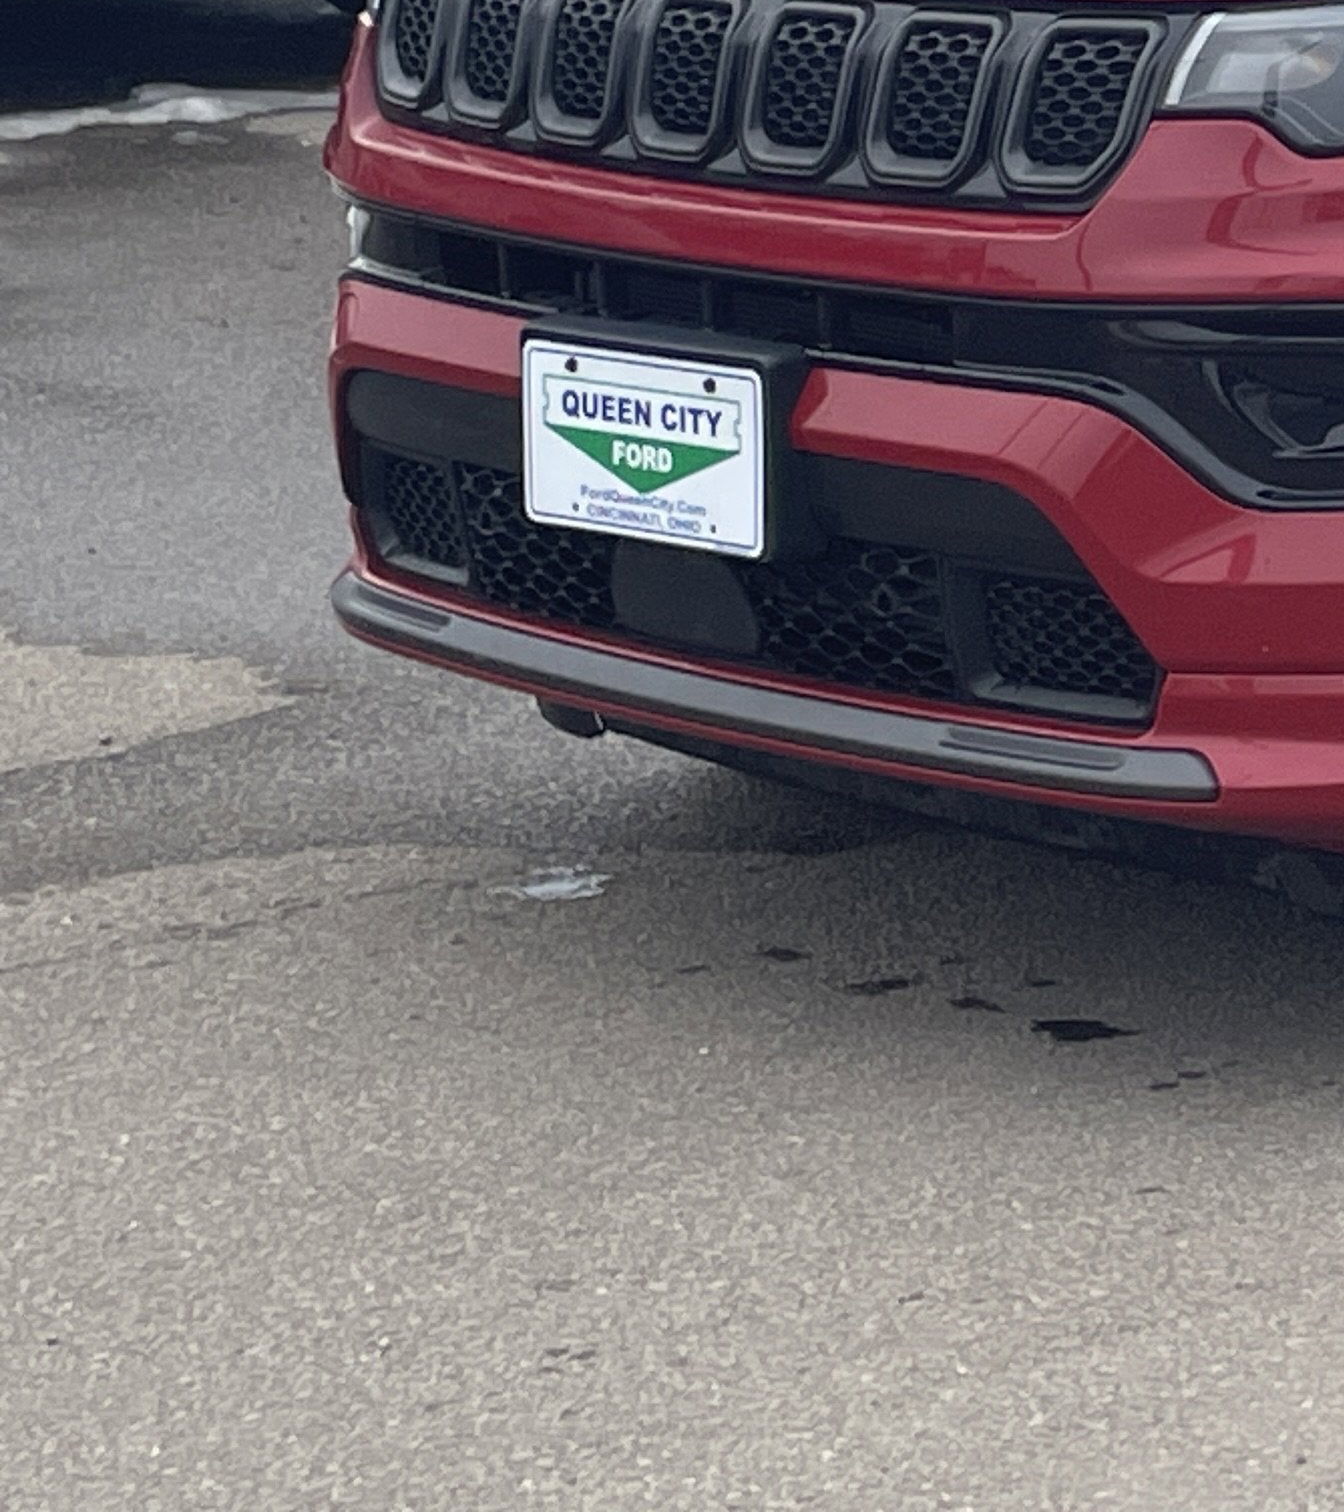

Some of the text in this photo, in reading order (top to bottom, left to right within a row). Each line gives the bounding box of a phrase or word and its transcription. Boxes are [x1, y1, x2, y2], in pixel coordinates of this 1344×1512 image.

[562, 389, 722, 437] QUEEN CITY
[612, 439, 673, 473] FORD
